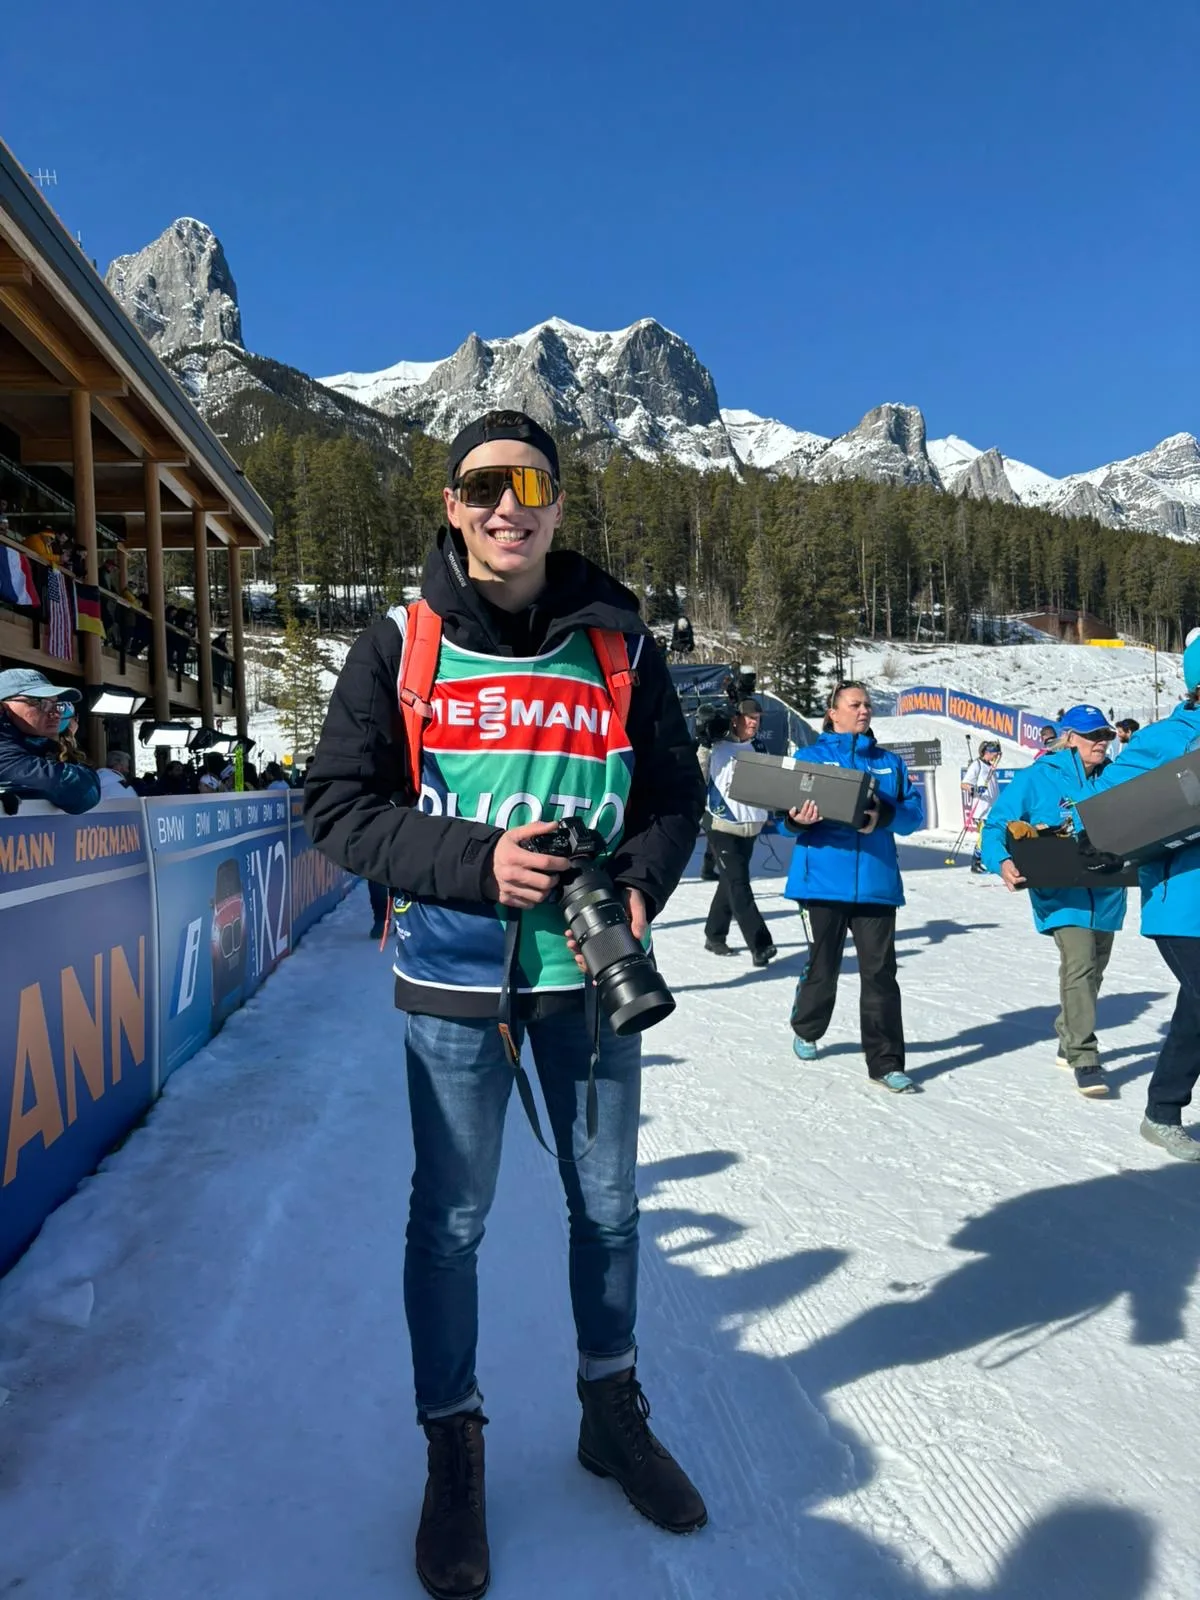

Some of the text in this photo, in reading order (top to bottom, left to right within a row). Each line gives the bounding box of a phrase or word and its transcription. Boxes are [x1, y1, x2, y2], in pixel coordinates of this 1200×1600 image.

[157, 815, 185, 844] BMW
[0, 832, 56, 874] MANN
[3, 935, 146, 1188] ANN
